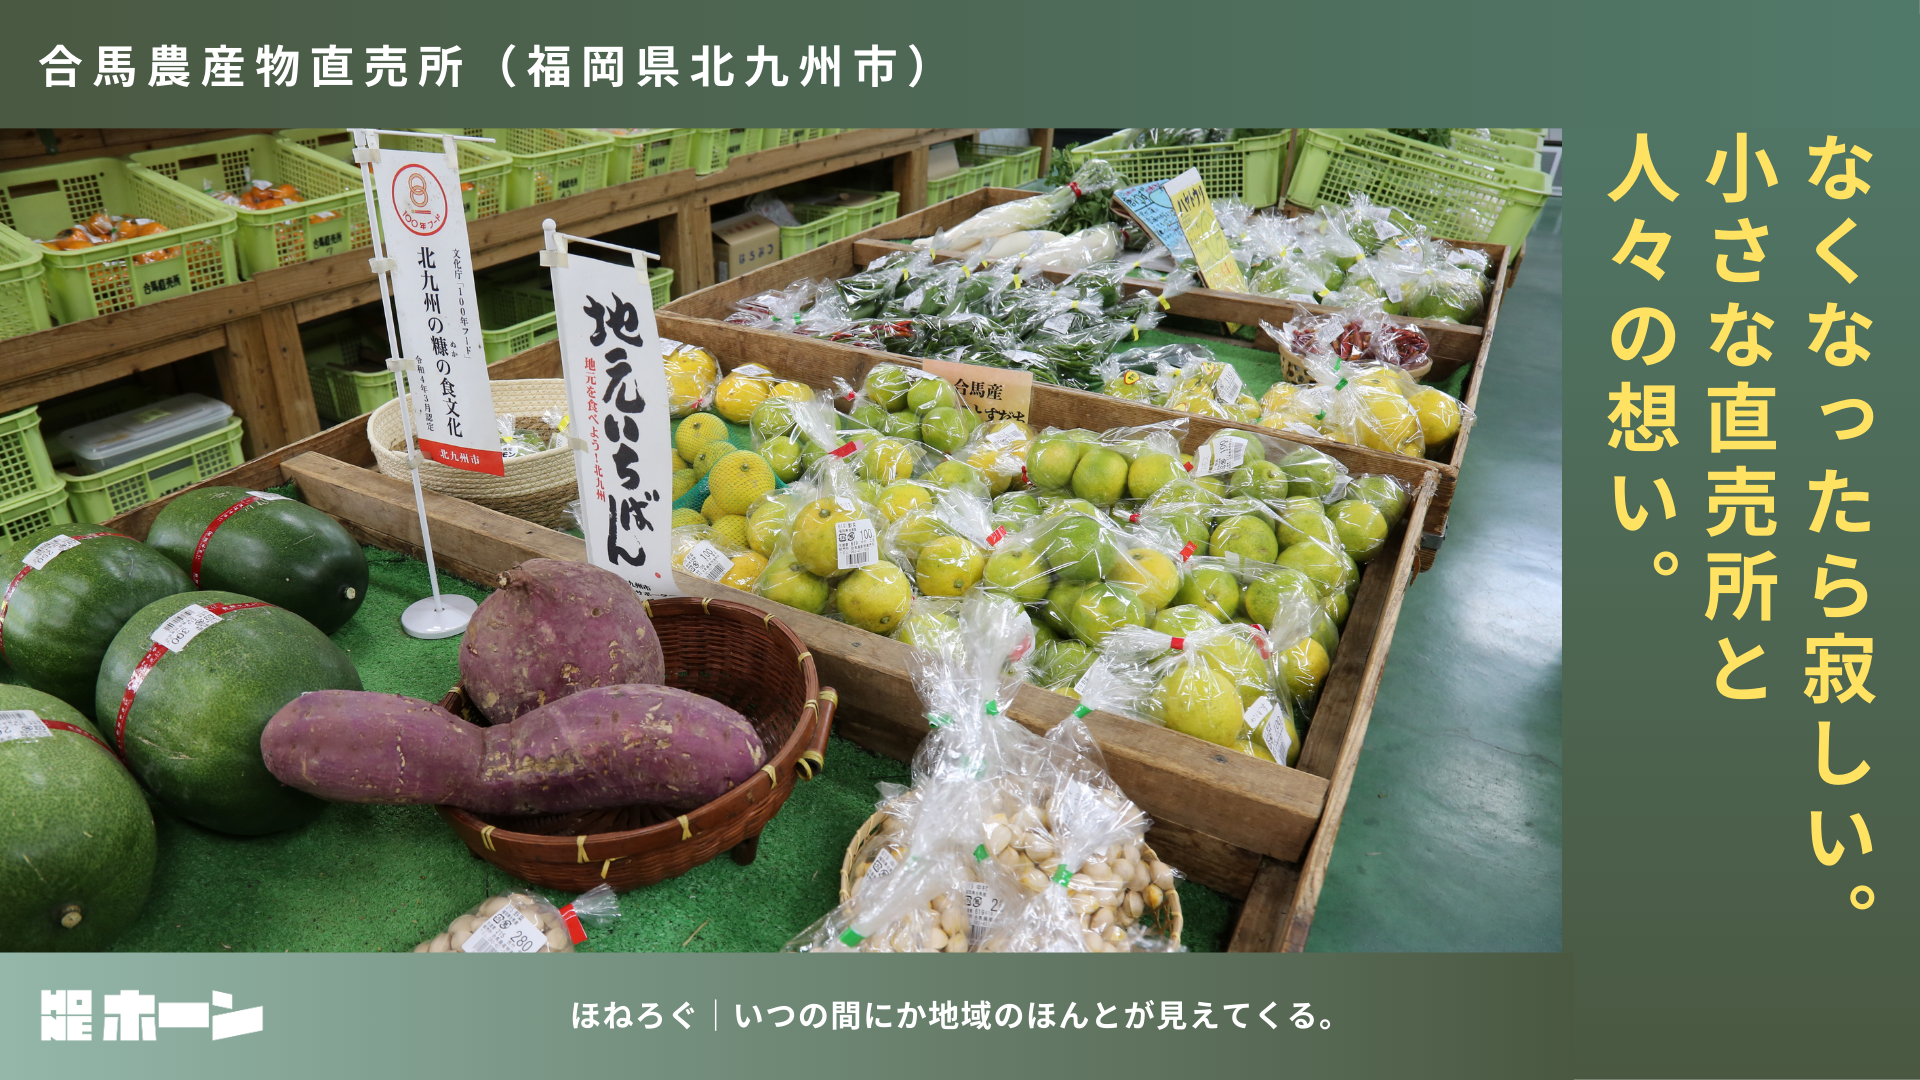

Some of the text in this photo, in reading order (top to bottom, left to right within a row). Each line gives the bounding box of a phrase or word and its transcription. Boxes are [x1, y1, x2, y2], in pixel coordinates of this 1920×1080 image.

[402, 209, 441, 230] 100年フード
[452, 248, 472, 359] 文化庁「100年フード」
[417, 246, 463, 438] 北九州の糠の食文化
[450, 341, 458, 358] ぬか
[415, 355, 435, 432] 令和4年3月認定
[954, 378, 1003, 401] 合馬産
[583, 291, 660, 567] 地元いちばん
[584, 357, 606, 503] 地元を食べよう！北九州
[440, 448, 480, 465] 北九州市
[860, 529, 872, 540] 100
[700, 548, 714, 561] 100
[171, 627, 190, 645] 300
[510, 930, 533, 952] 280
